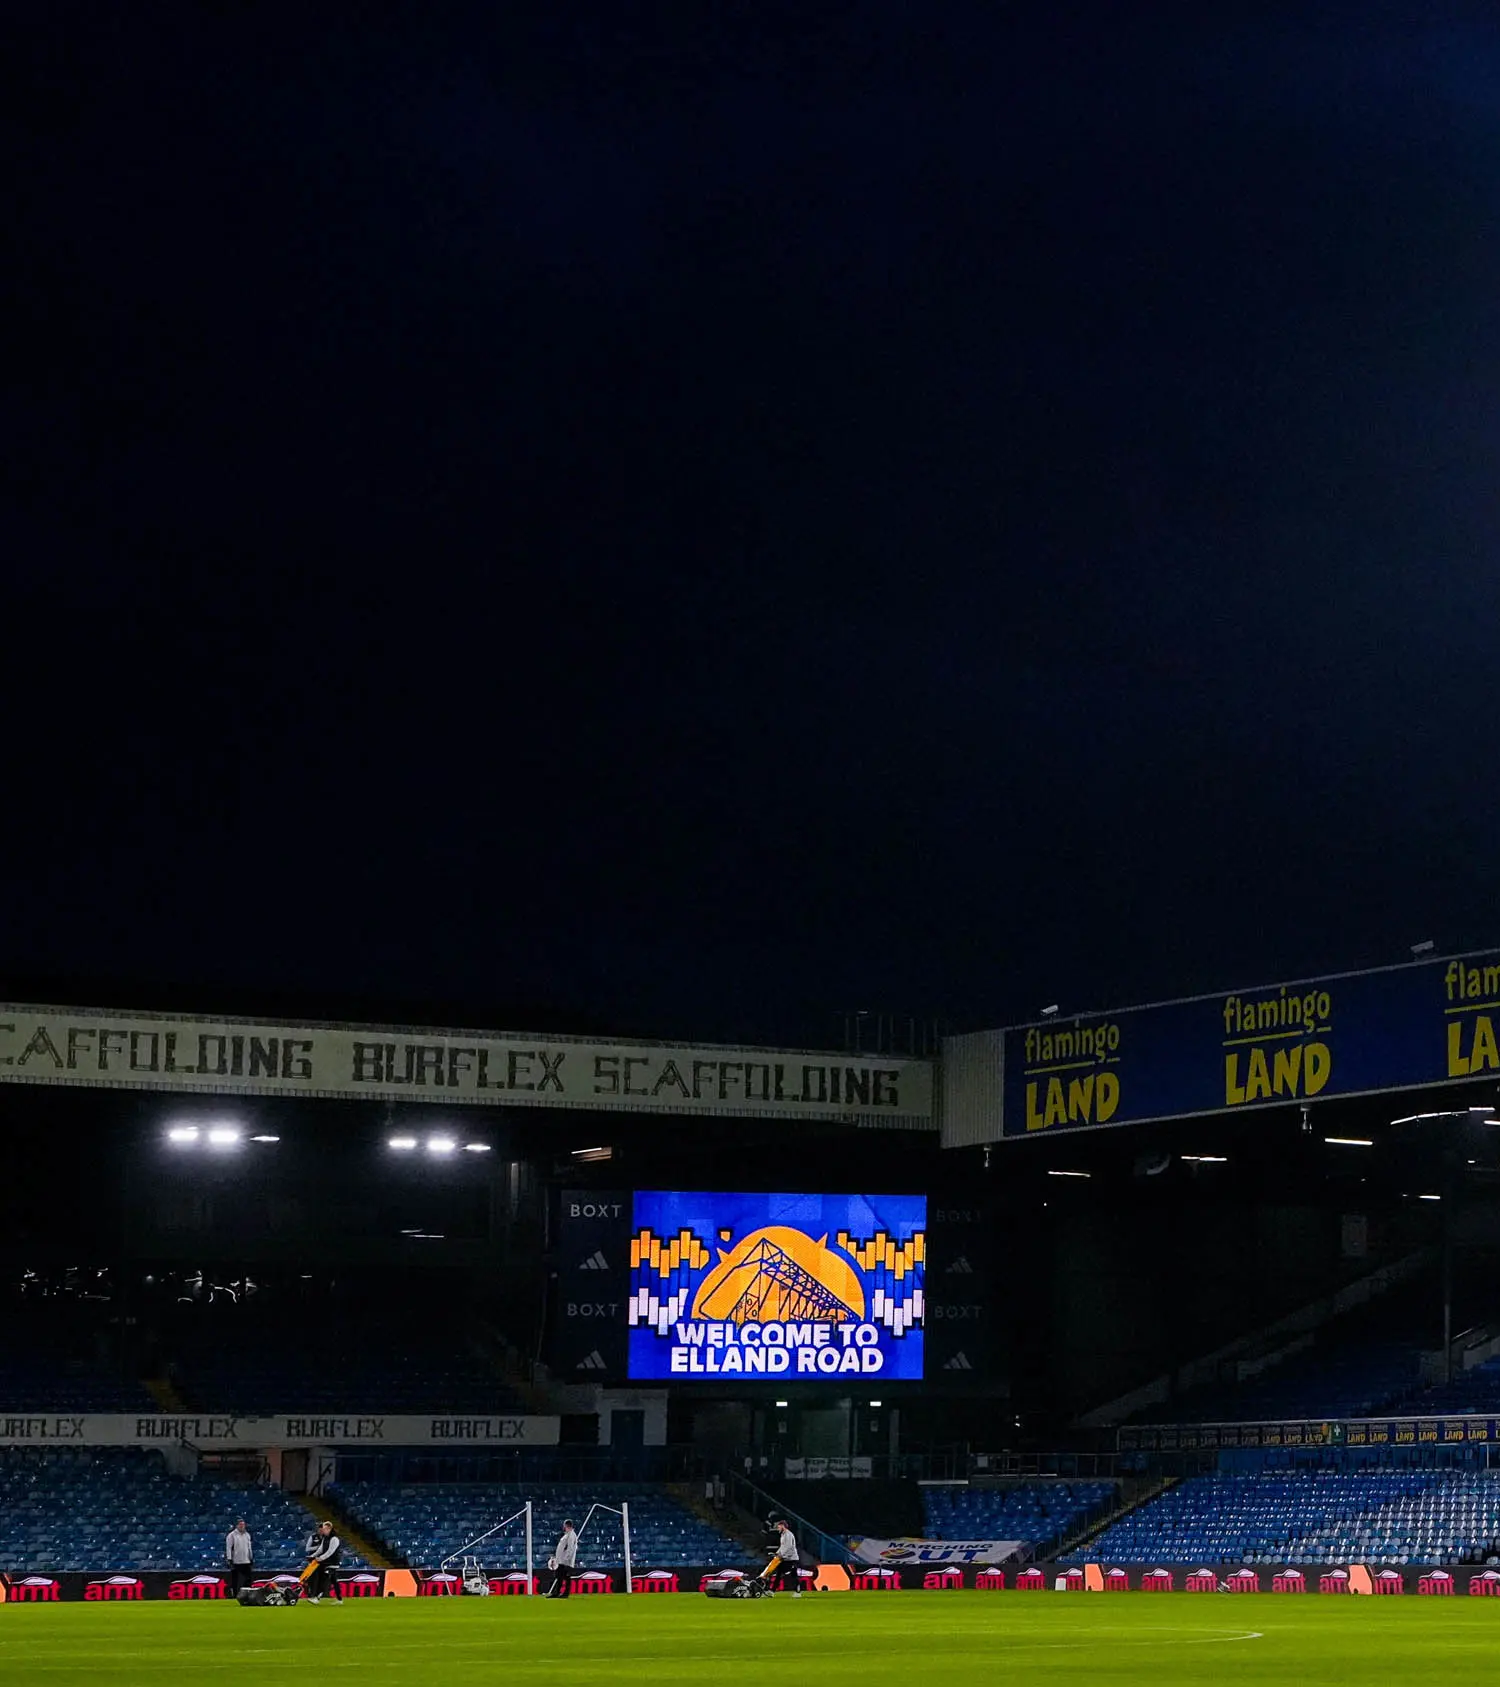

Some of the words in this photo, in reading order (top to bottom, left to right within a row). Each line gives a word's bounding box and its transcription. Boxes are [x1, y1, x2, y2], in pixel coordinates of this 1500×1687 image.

[1223, 987, 1331, 1033] flamingo
[1024, 1019, 1120, 1063] flamingo
[352, 1041, 565, 1093] BURFLEX
[595, 1055, 898, 1107] SCAFFOLDING
[1225, 1042, 1332, 1106] LAND
[1026, 1072, 1120, 1131] LAND
[570, 1203, 621, 1218] BOXT
[567, 1303, 618, 1318] BOXT
[935, 1305, 983, 1319] BOXT
[676, 1323, 831, 1346] WELCOME
[838, 1324, 878, 1346] TO
[671, 1347, 789, 1373] ELLAND
[800, 1347, 884, 1373] ROAD
[136, 1418, 238, 1438] BURFLEX
[287, 1418, 384, 1438] BURFLEX
[431, 1419, 525, 1439] BURFLEX
[1396, 1432, 1414, 1442] LAND
[1418, 1431, 1437, 1441] LAND
[1445, 1431, 1464, 1440] LAND
[1468, 1430, 1487, 1439] LAND
[1347, 1432, 1365, 1443] LAND
[1369, 1432, 1388, 1443] LAND
[888, 1541, 993, 1550] MARCHING
[84, 1579, 145, 1600] amt
[167, 1579, 228, 1600] amt
[632, 1575, 680, 1593] amt
[923, 1572, 964, 1590] amt
[976, 1572, 1005, 1590] amt
[1016, 1572, 1045, 1590] amt
[1141, 1574, 1174, 1592] amt
[1186, 1573, 1217, 1592] amt
[1226, 1574, 1260, 1592] amt
[1272, 1574, 1306, 1593] amt
[1320, 1575, 1348, 1593] am
[1418, 1575, 1454, 1596] amt
